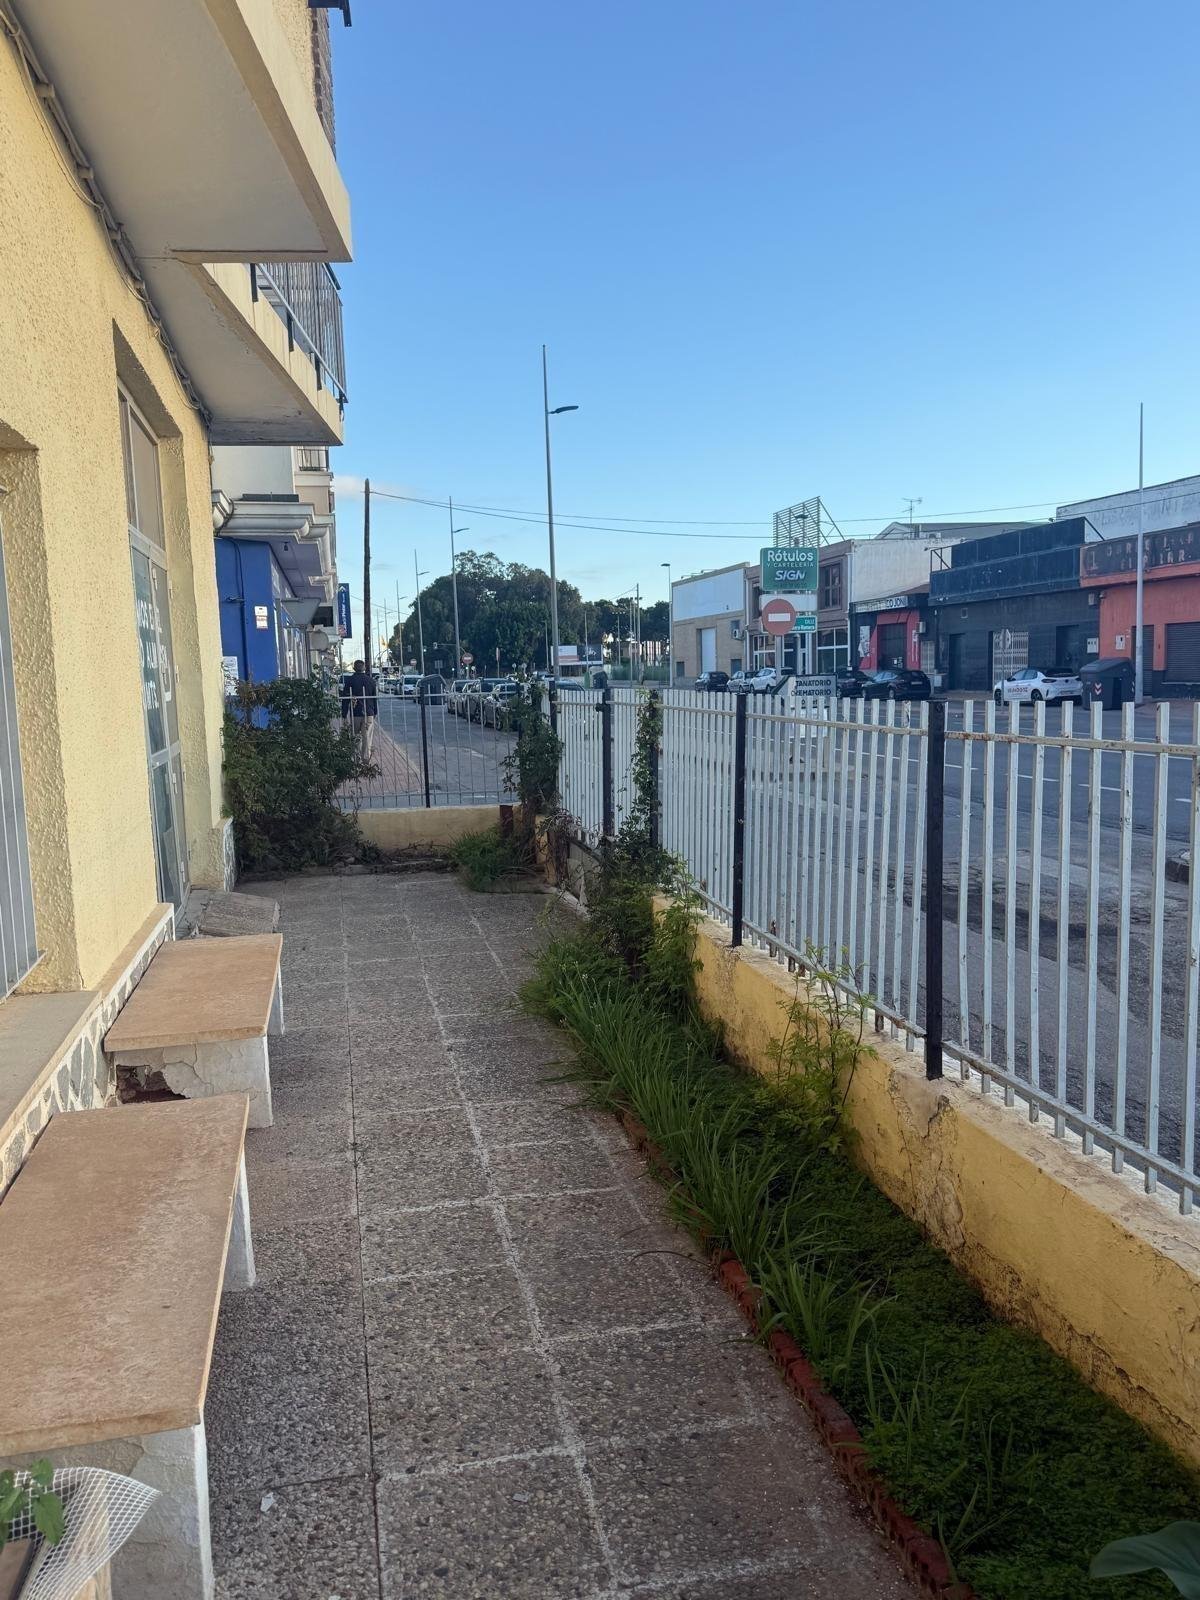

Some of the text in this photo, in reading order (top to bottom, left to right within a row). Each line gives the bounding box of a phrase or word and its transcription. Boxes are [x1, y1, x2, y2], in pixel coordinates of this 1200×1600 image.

[767, 550, 814, 562] Rótulos
[775, 570, 806, 581] SIGN
[796, 679, 831, 687] TANATORIO
